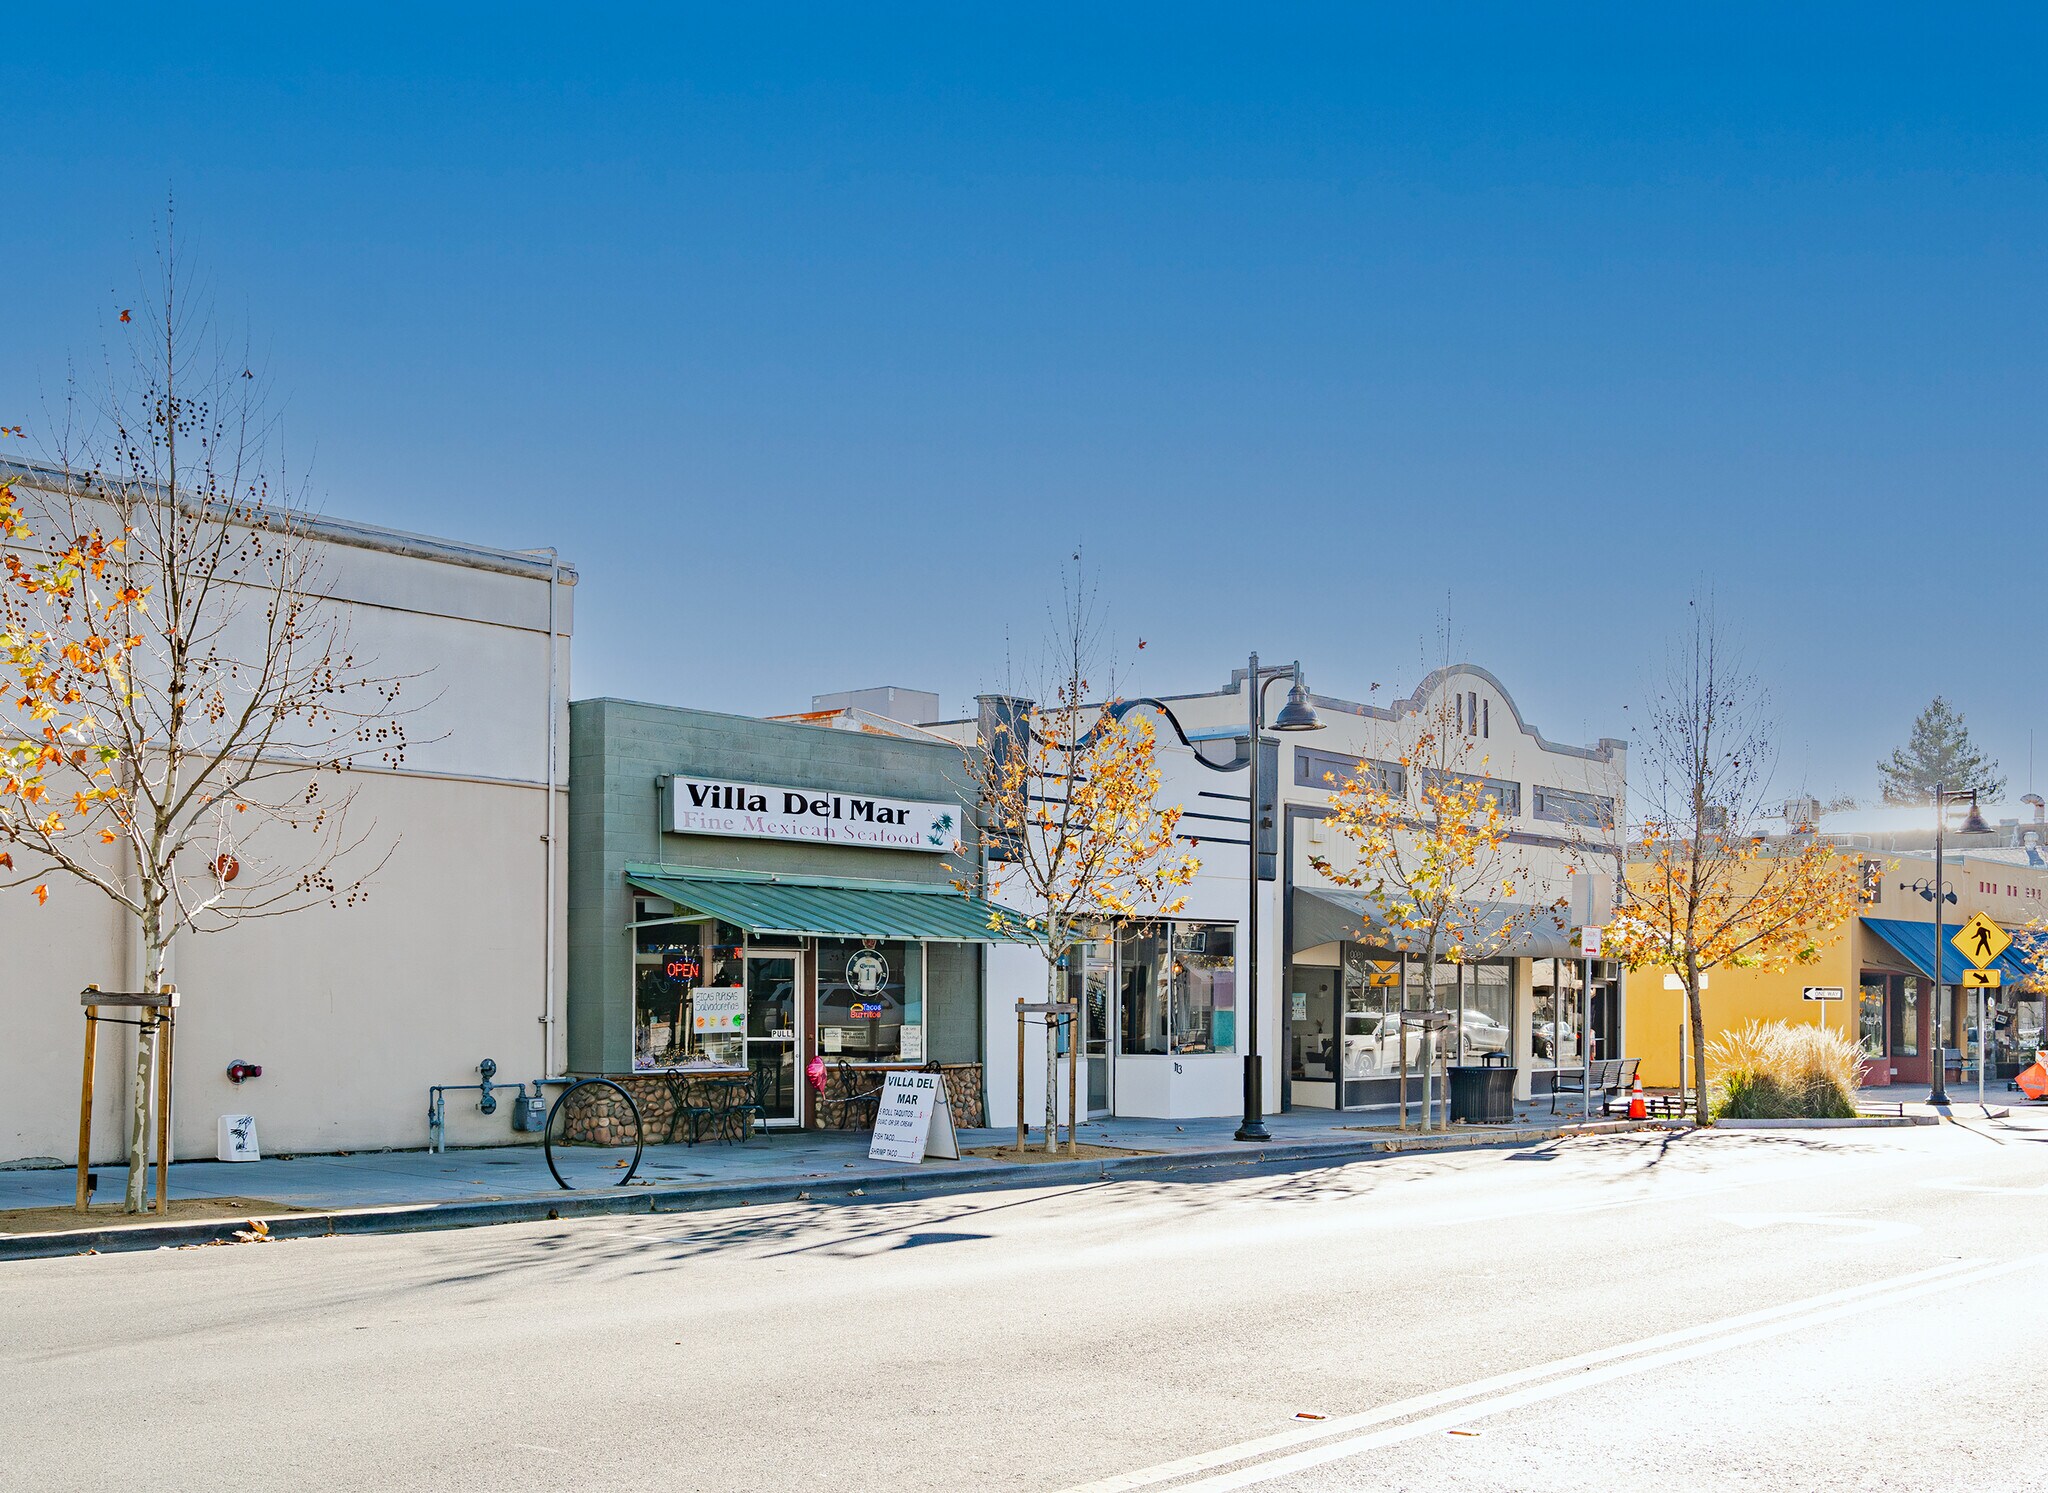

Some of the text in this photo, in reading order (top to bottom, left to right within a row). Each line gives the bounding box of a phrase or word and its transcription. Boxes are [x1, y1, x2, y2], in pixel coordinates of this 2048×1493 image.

[686, 783, 911, 825] Villa Del Mar
[683, 811, 920, 845] Fine Mexican Seafood
[667, 962, 699, 977] OPEN
[715, 992, 738, 1001] PUPUSAS
[862, 1003, 882, 1011] Tacos
[850, 1010, 881, 1018] Burritos
[771, 1030, 791, 1038] PULL
[888, 1076, 935, 1089] VILLA DEL
[896, 1094, 918, 1105] MAR
[882, 1108, 893, 1117] ROLL
[893, 1109, 914, 1118] TAQUITOS
[874, 1132, 883, 1140] FISH
[884, 1133, 895, 1142] TACO
[886, 1148, 898, 1158] TACO
